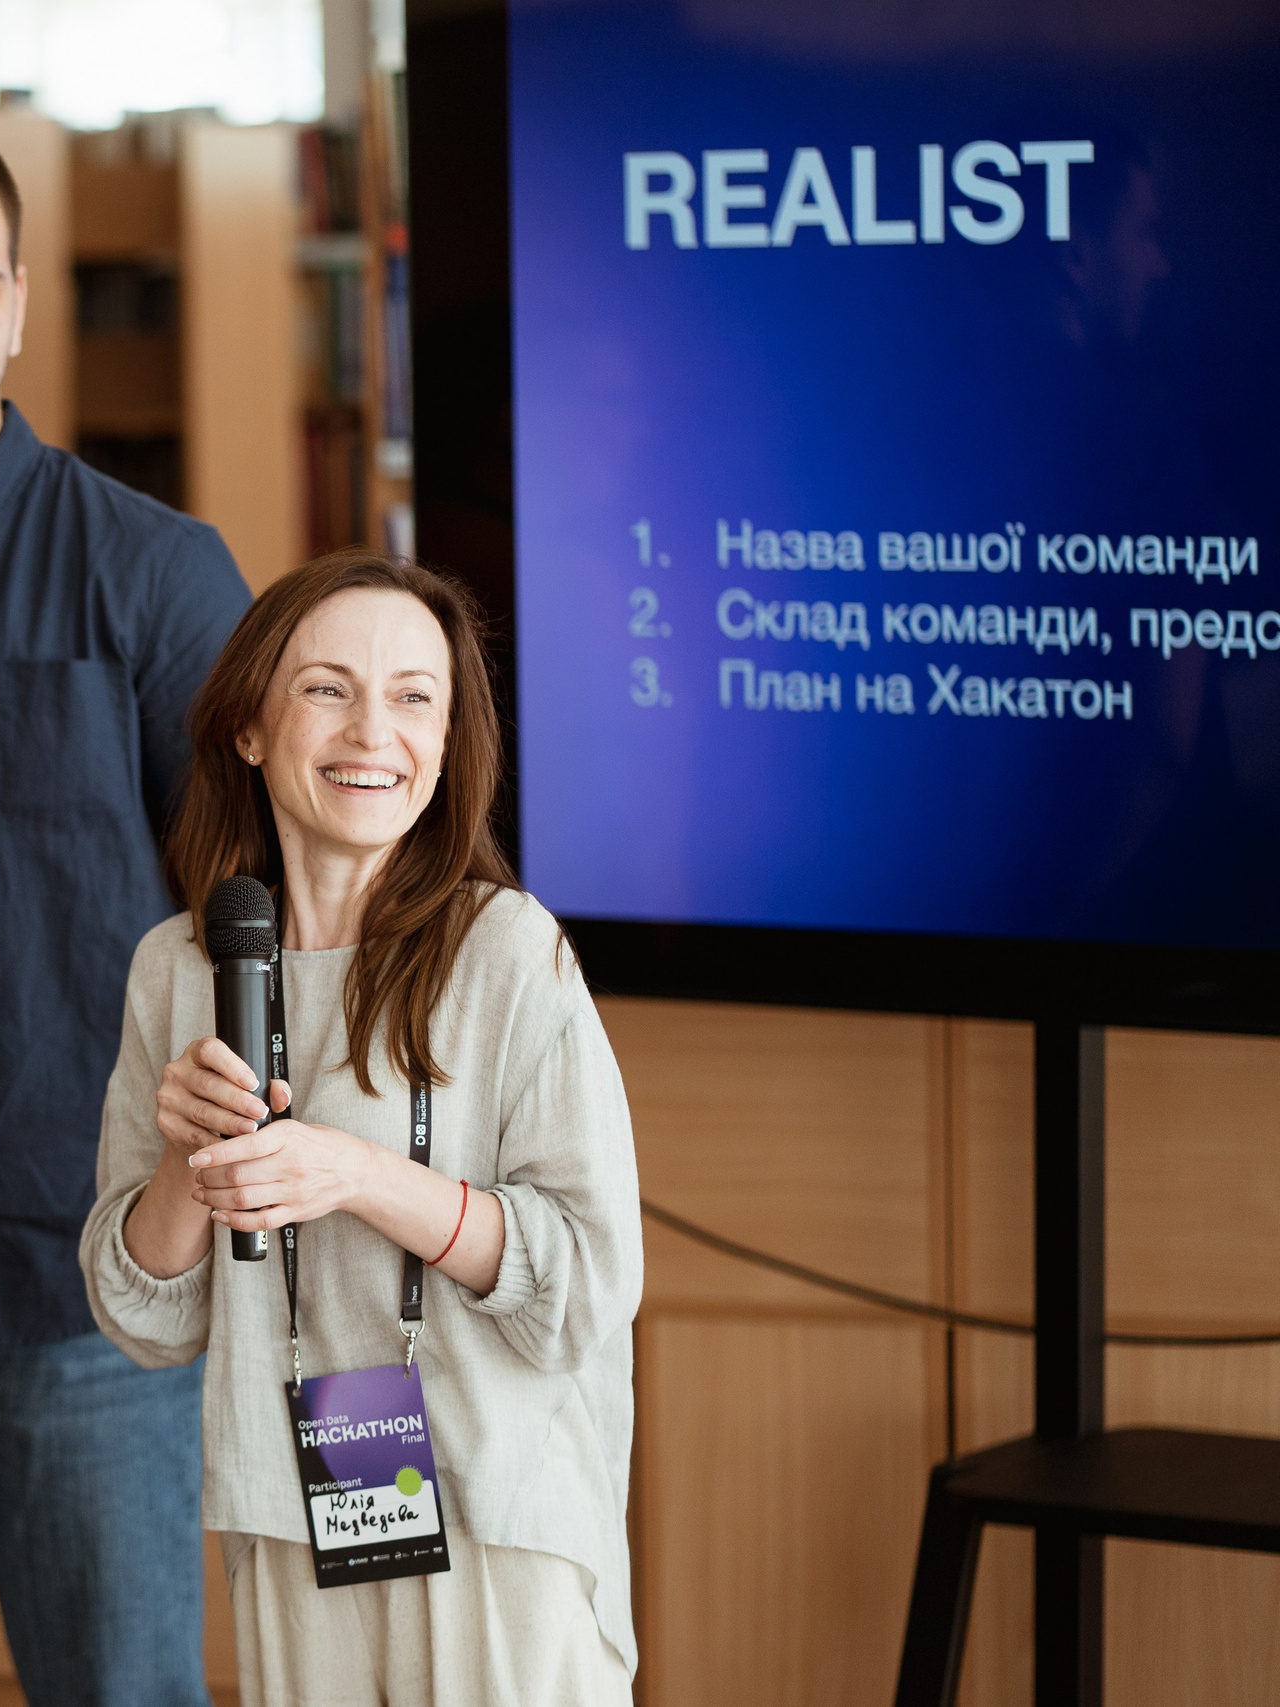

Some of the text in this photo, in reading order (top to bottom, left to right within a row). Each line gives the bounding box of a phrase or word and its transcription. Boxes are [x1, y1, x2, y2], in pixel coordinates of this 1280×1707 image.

[623, 140, 1095, 249] REALIST
[630, 519, 1260, 584] 1. Назва вашої команди
[629, 589, 672, 638] 2.
[717, 590, 870, 650] Склад
[883, 603, 1112, 655] команди,
[630, 657, 1133, 719] 3. План на Хакатон
[298, 1415, 349, 1430] Open Data
[300, 1414, 424, 1448] HACKATHON
[401, 1432, 426, 1445] Final
[308, 1477, 363, 1494] Participant
[329, 1491, 375, 1511] Юлія
